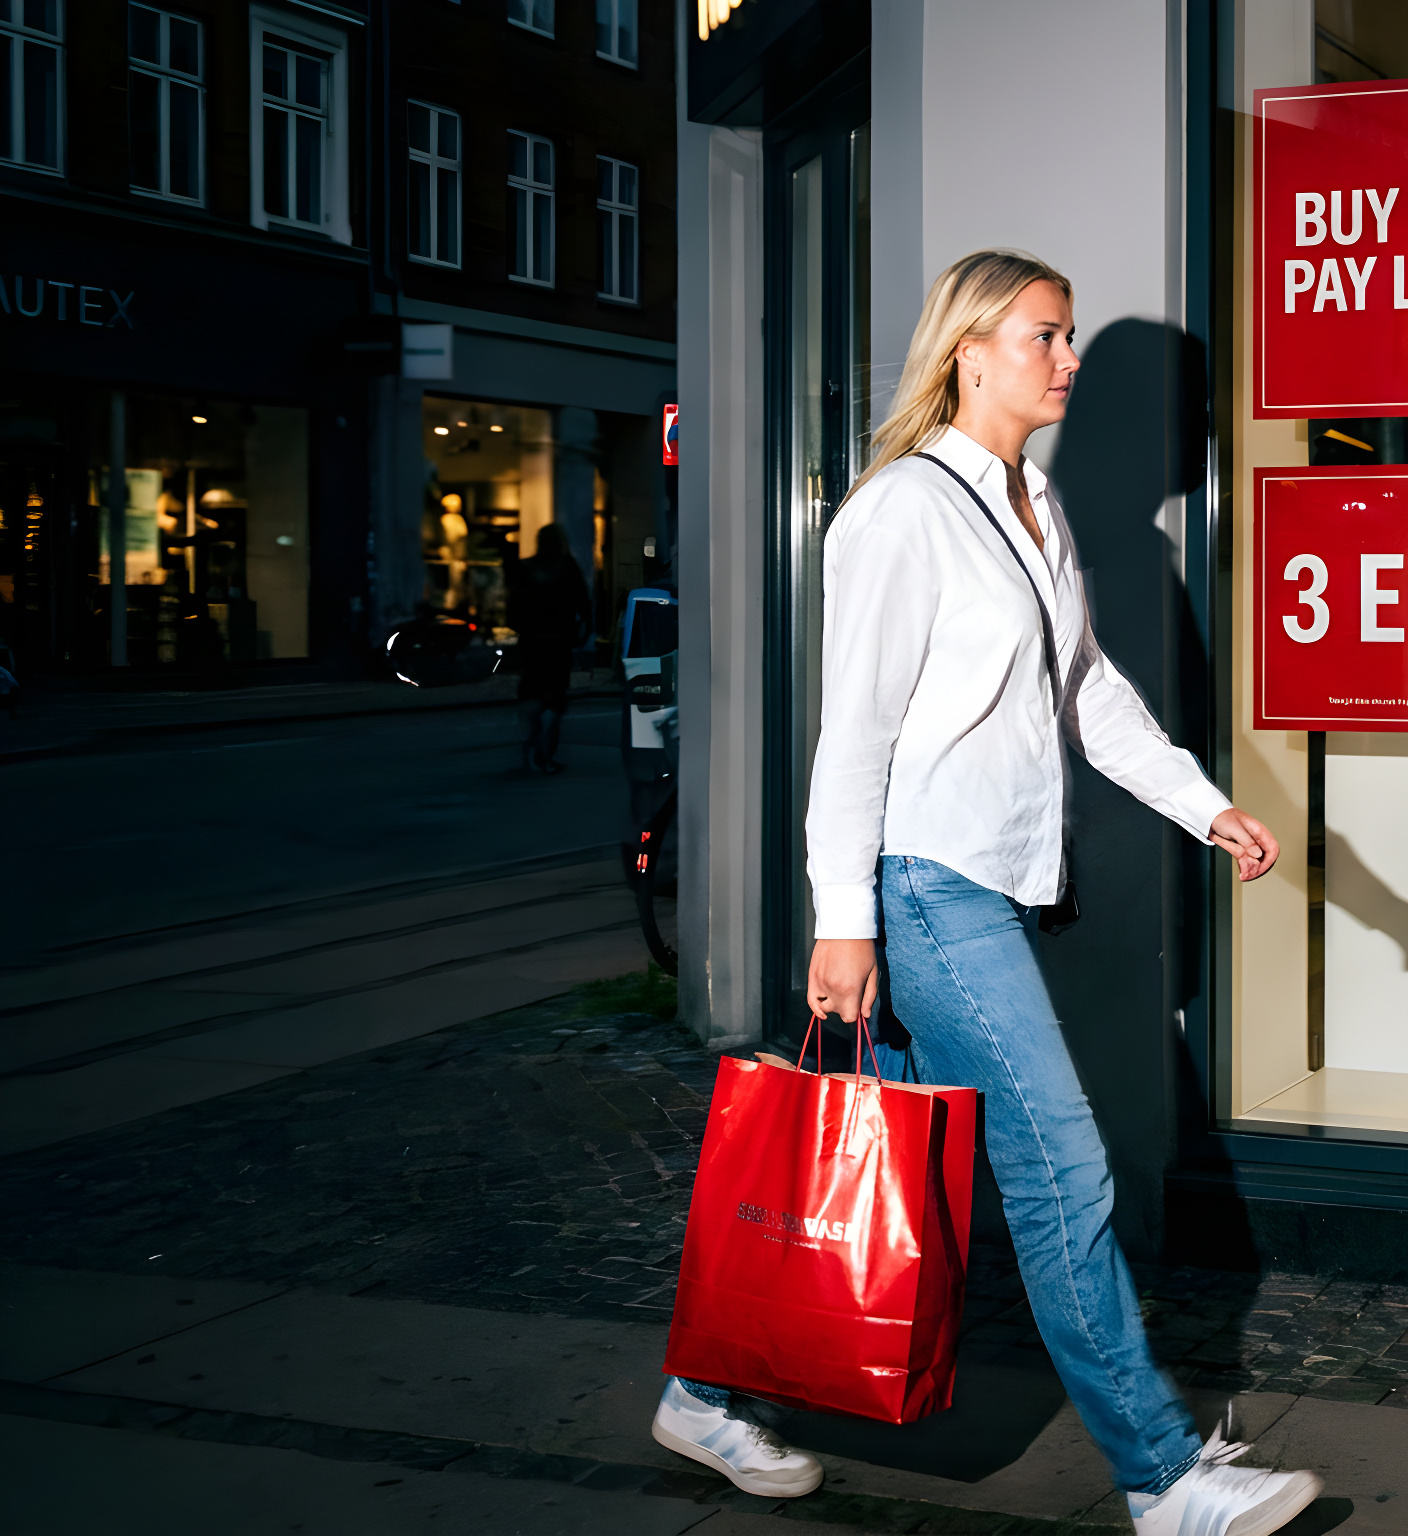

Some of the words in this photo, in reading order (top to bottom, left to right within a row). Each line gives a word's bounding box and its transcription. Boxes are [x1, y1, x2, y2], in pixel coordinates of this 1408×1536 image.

[1295, 188, 1400, 247] BUY
[1284, 256, 1378, 314] PAY
[1282, 553, 1330, 644] 3
